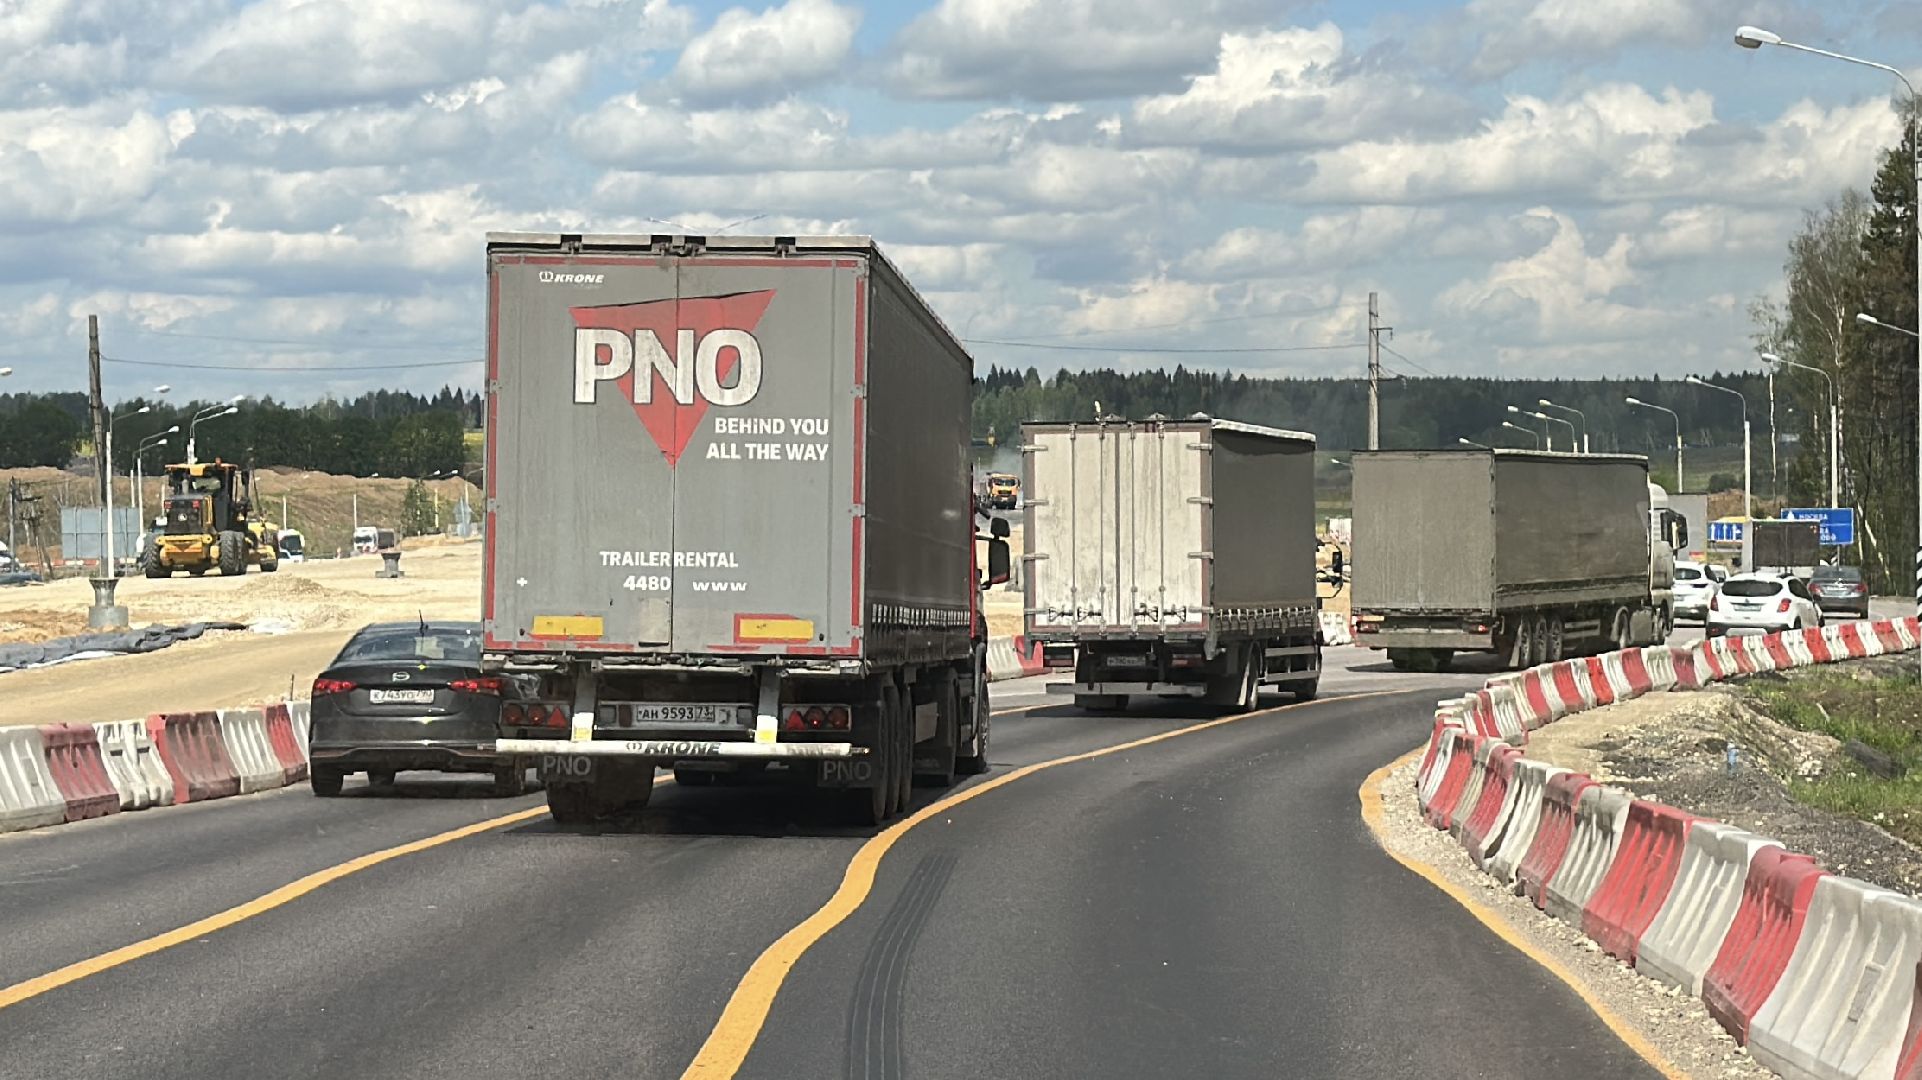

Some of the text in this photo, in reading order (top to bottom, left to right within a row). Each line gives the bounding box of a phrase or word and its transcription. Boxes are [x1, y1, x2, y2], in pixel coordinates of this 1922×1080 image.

[554, 273, 605, 283] KRONE
[573, 327, 763, 406] PNO
[714, 417, 829, 435] BEHIND YOU
[706, 442, 829, 461] ALL THE WAY
[600, 551, 739, 567] TRAILER RENTAL
[623, 575, 672, 591] 4480
[644, 742, 722, 755] KRONE
[542, 755, 592, 776] PNO
[823, 760, 872, 780] PNO
